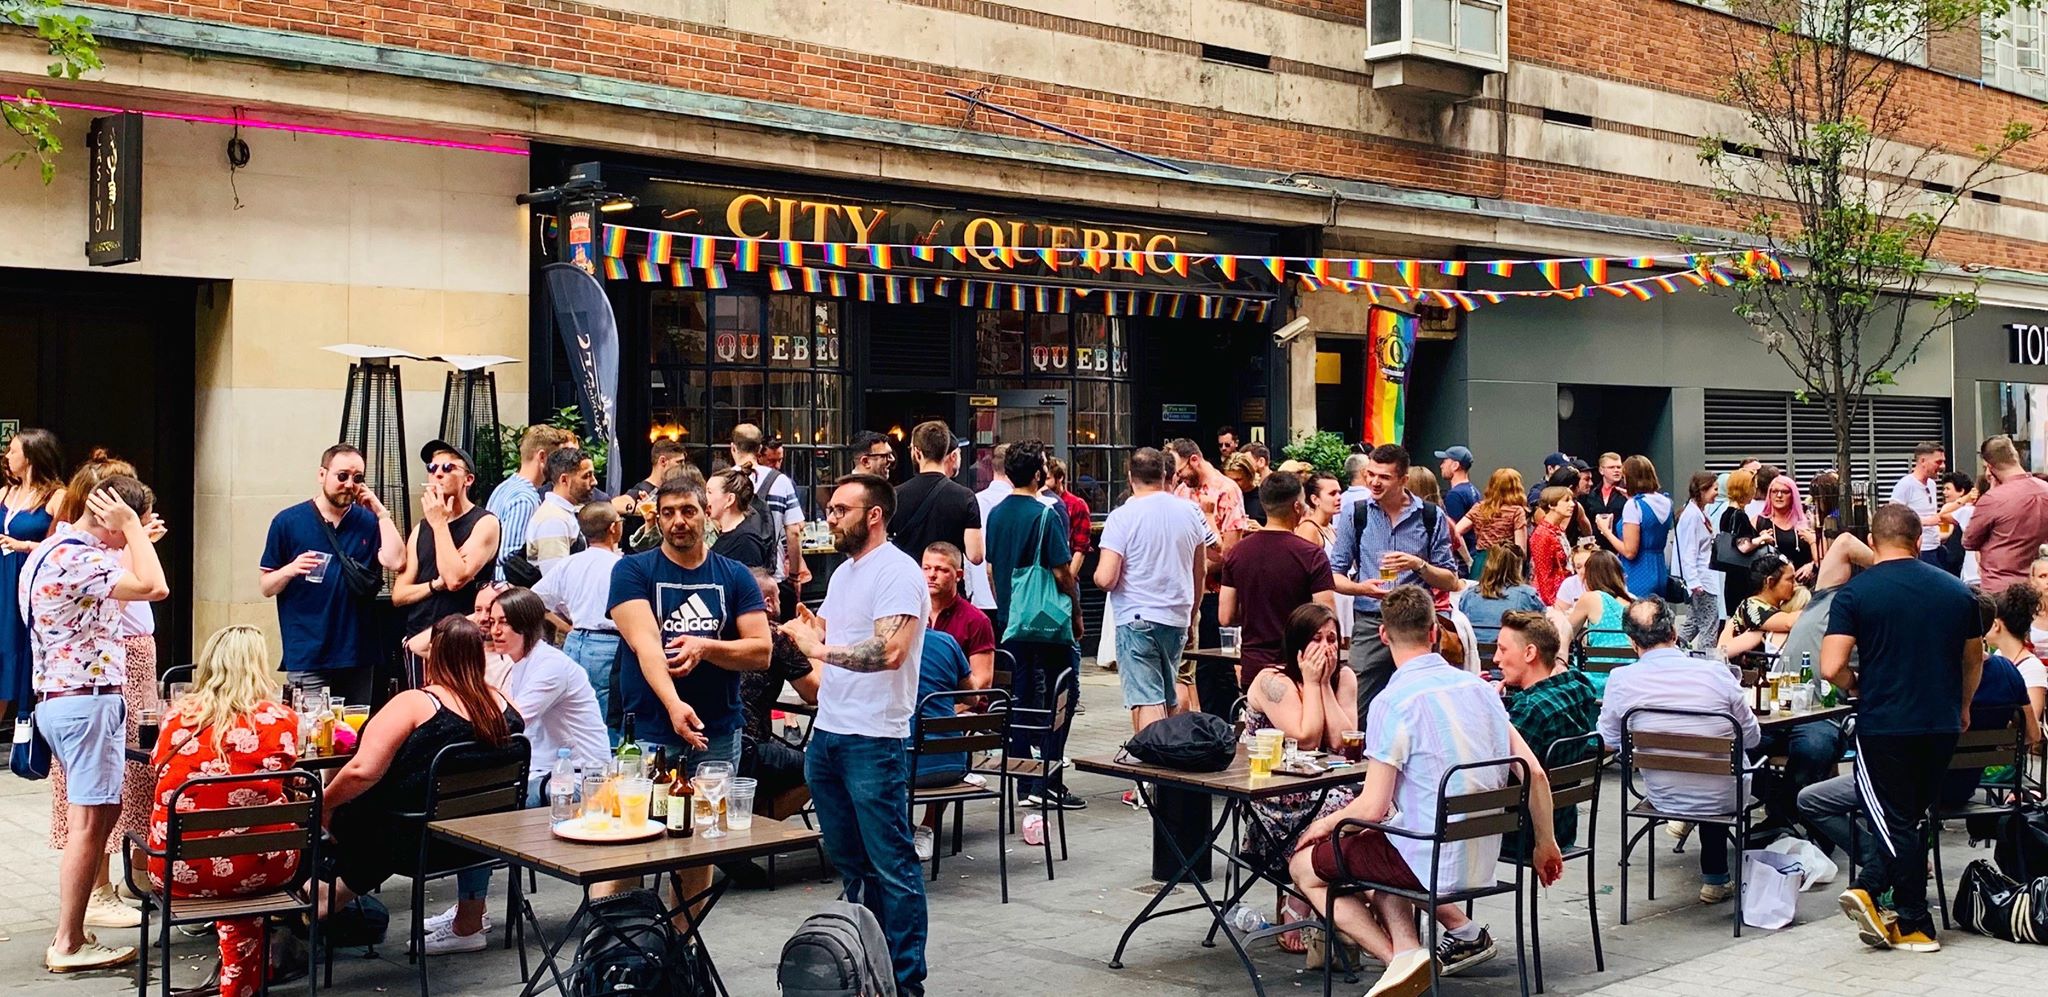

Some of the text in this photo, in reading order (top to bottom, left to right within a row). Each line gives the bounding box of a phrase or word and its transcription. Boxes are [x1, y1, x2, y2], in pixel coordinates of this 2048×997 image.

[726, 194, 888, 248] CITY
[963, 217, 1177, 274] QUEBEC
[716, 332, 839, 361] QUEBEC
[1032, 345, 1128, 372] QUEBEC
[663, 617, 719, 632] adidas
